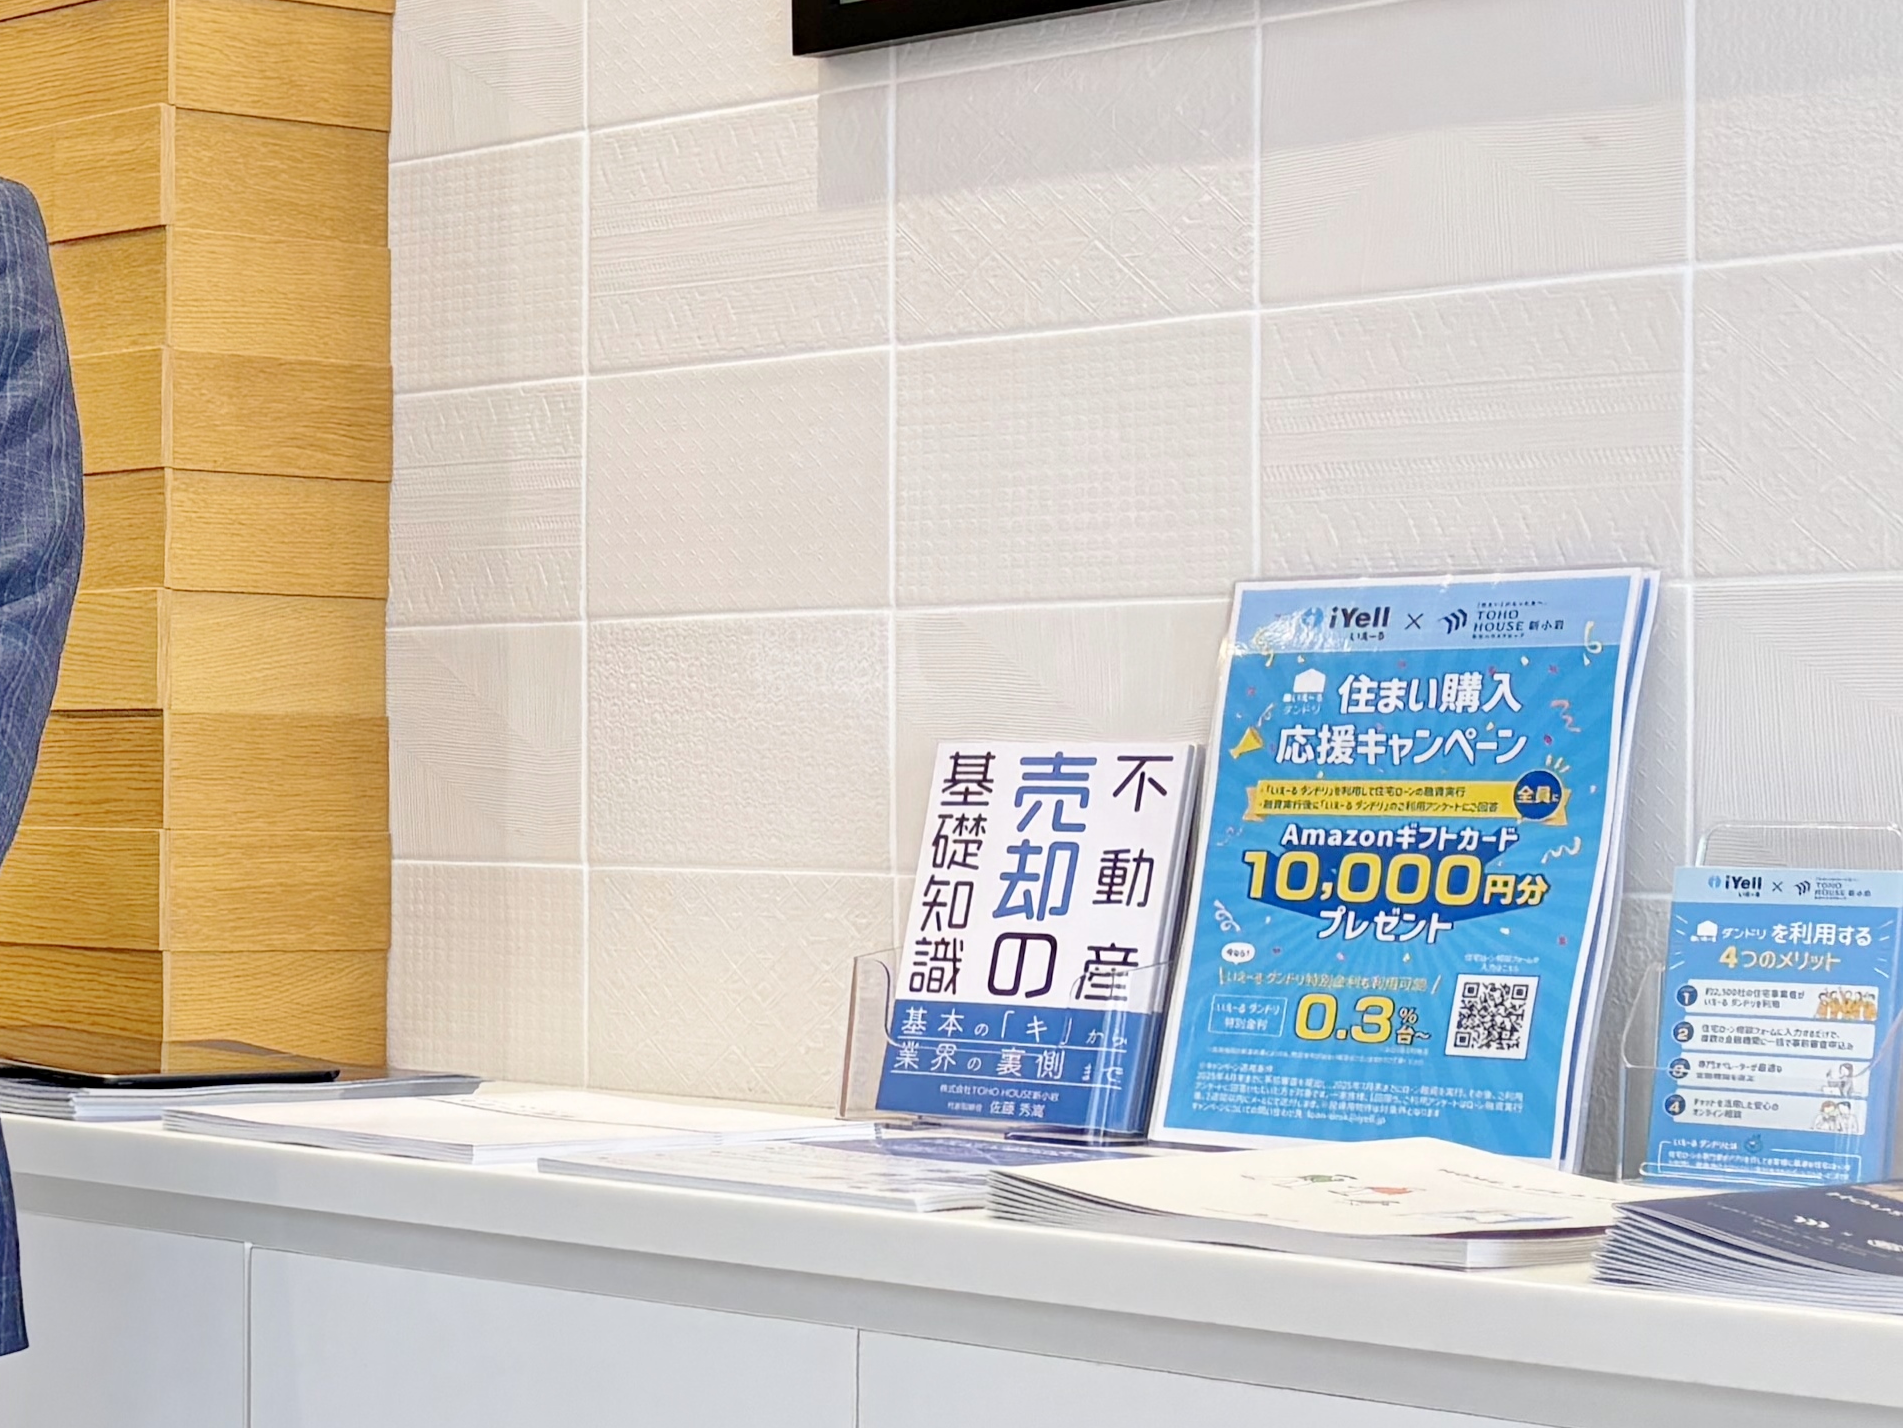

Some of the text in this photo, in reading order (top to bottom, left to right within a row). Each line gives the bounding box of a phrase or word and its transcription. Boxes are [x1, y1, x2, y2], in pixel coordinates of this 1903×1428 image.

[1329, 606, 1390, 629] iYell
[1474, 621, 1524, 632] HOUSE
[1477, 610, 1519, 621] TOHO
[1338, 672, 1523, 715] 住まい購入
[1275, 724, 1528, 766] 応援キャンペーン
[1280, 823, 1520, 852] Amazonギフトカード
[909, 751, 996, 996] 基礎知識
[987, 751, 1098, 999] 売却の
[1074, 754, 1174, 1001] 不動産
[1243, 849, 1550, 907] 10,000円分
[1725, 875, 1762, 890] iYell
[1317, 905, 1455, 945] プレゼント
[1771, 921, 1873, 946] を利用する
[1718, 945, 1842, 972] 4つのメリット
